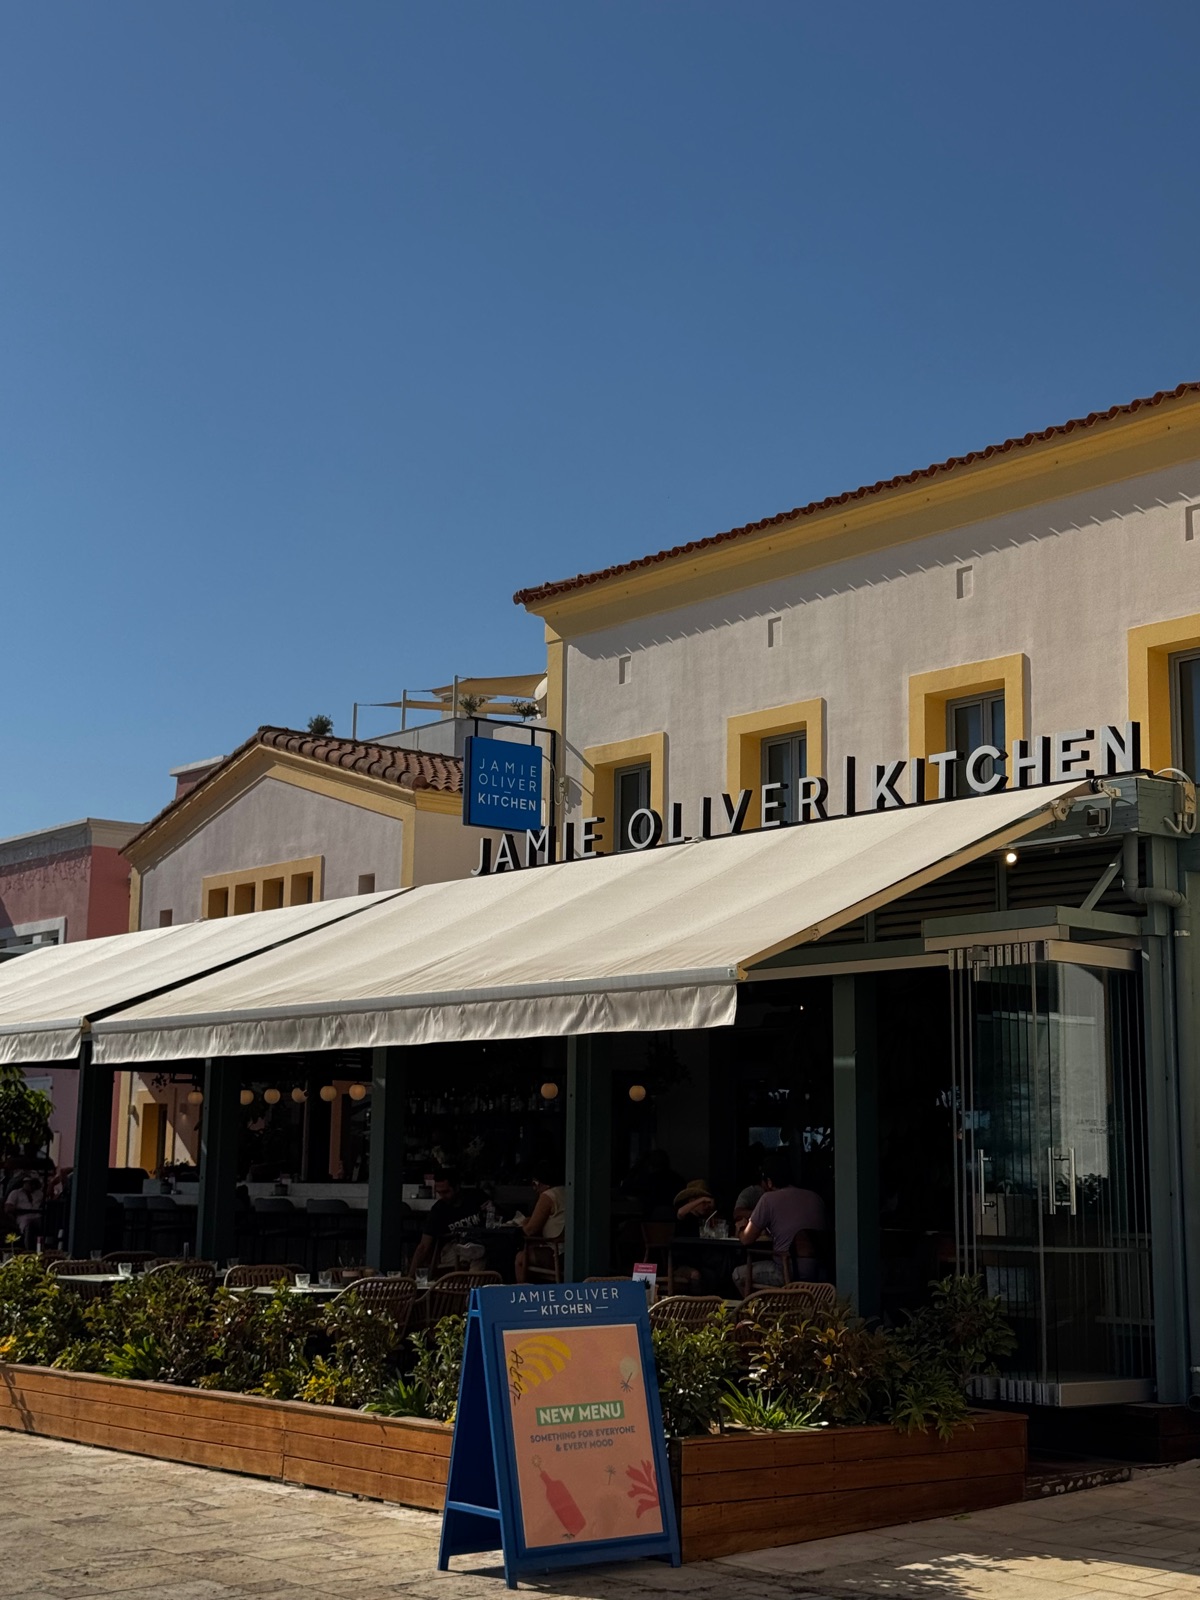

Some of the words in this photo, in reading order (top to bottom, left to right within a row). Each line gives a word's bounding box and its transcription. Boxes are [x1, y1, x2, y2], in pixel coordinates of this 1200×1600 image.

[479, 758, 537, 778] JAMIE
[478, 773, 537, 793] OLIVER
[470, 816, 605, 876] JAMIE
[627, 776, 829, 850] OLIVER
[870, 721, 1141, 810] KITCHEN
[478, 792, 536, 812] KITCHEN
[510, 1290, 556, 1304] JAMIE
[564, 1287, 619, 1301] OLIVER
[540, 1303, 592, 1316] KITCHEN
[539, 1406, 575, 1425] NEW
[578, 1402, 622, 1421] MENU
[529, 1431, 577, 1444] SOMETHING
[577, 1429, 594, 1439] FOR
[595, 1425, 636, 1438] EVERYONE
[555, 1444, 562, 1452] &
[563, 1441, 587, 1452] EVERY
[589, 1438, 614, 1449] MOOD
